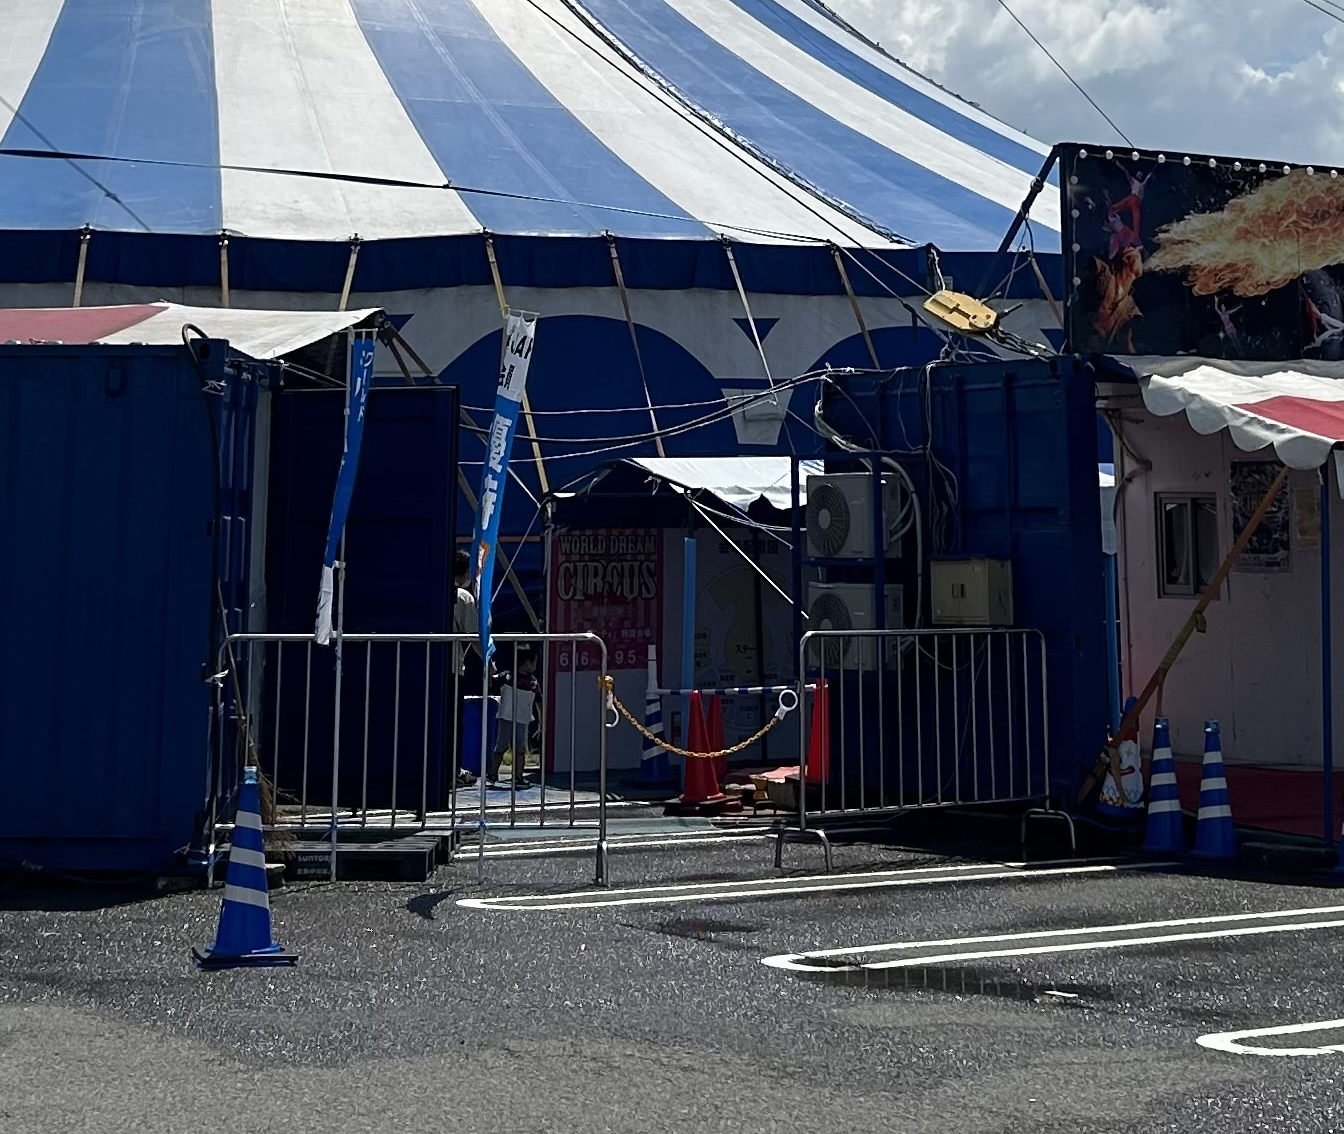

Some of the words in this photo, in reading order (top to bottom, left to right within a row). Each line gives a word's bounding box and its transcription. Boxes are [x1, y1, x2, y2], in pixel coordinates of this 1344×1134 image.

[559, 535, 605, 554] WORLD
[608, 534, 656, 554] DREAM
[557, 560, 657, 601] CIRCUS
